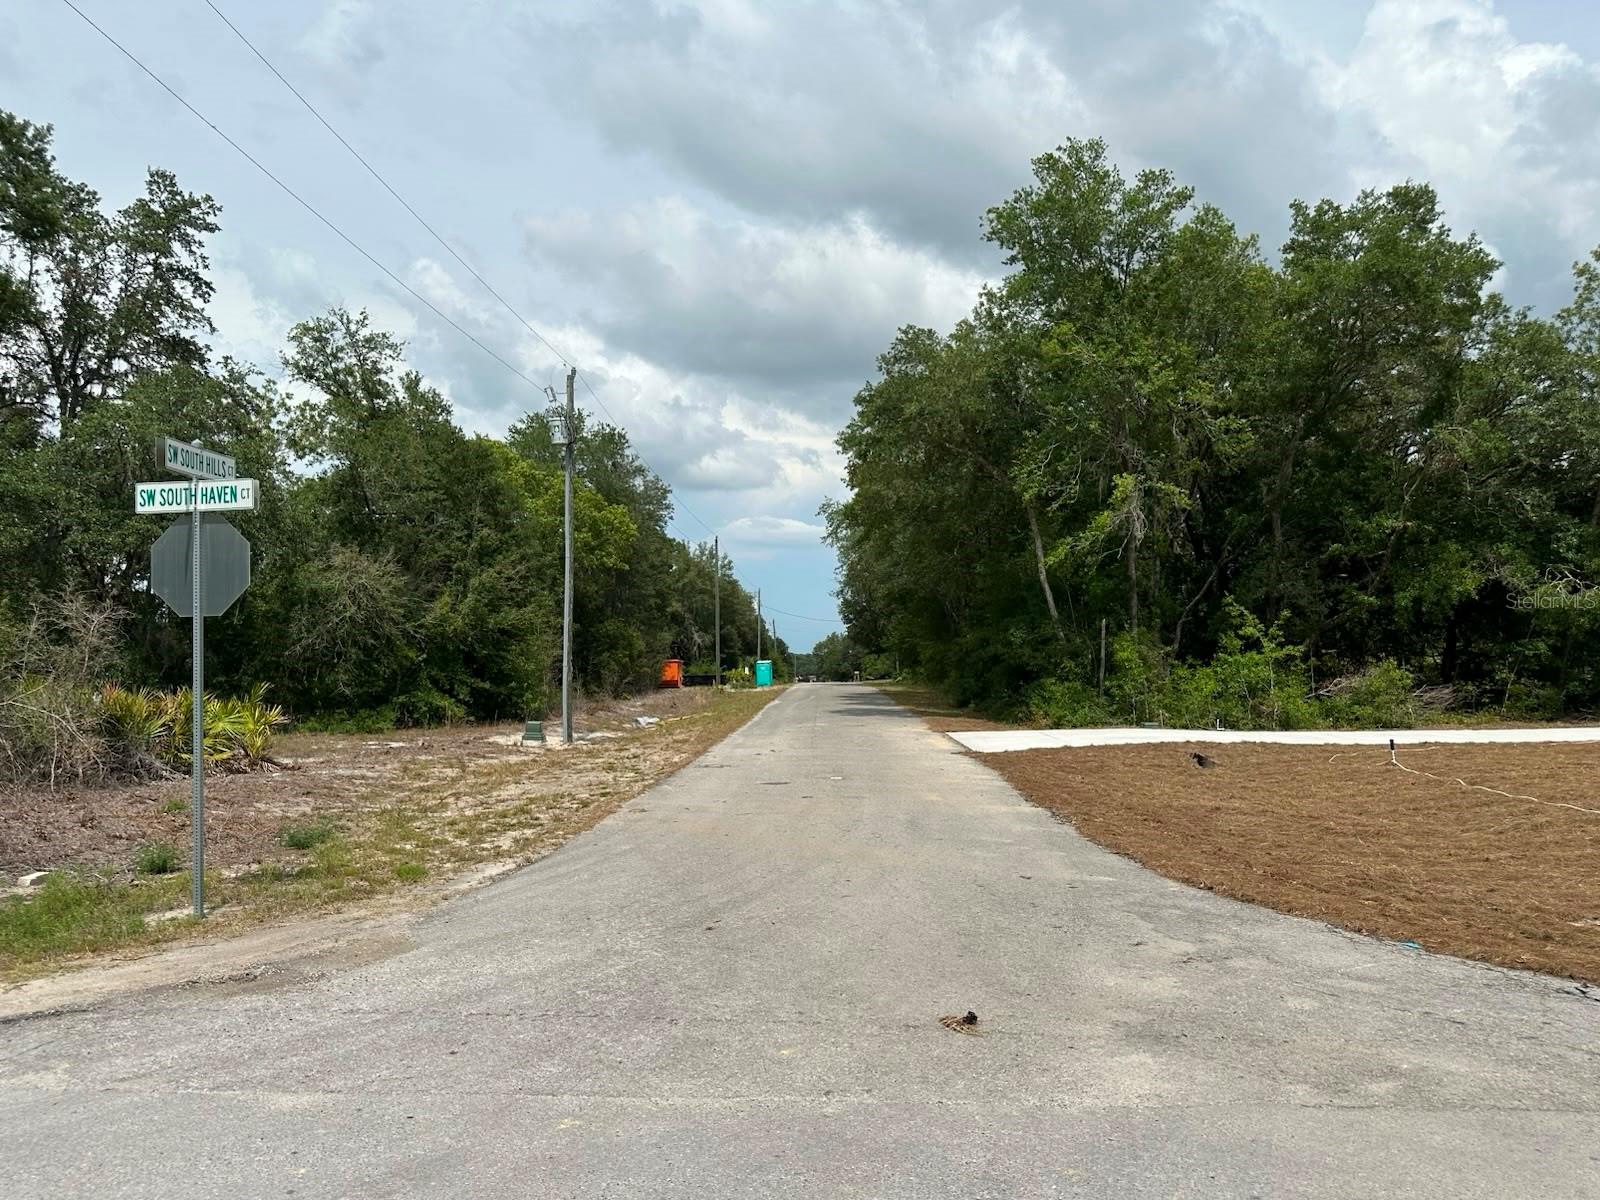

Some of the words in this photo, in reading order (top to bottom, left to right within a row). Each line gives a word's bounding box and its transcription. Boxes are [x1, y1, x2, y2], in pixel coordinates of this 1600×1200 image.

[168, 444, 178, 464] SW
[181, 448, 204, 472] SOUTH
[206, 455, 226, 478] HILLS
[227, 465, 234, 477] CT
[139, 488, 156, 507] SW
[159, 487, 197, 506] SOUTH
[200, 485, 237, 504] HAVEN
[240, 488, 250, 499] CT
